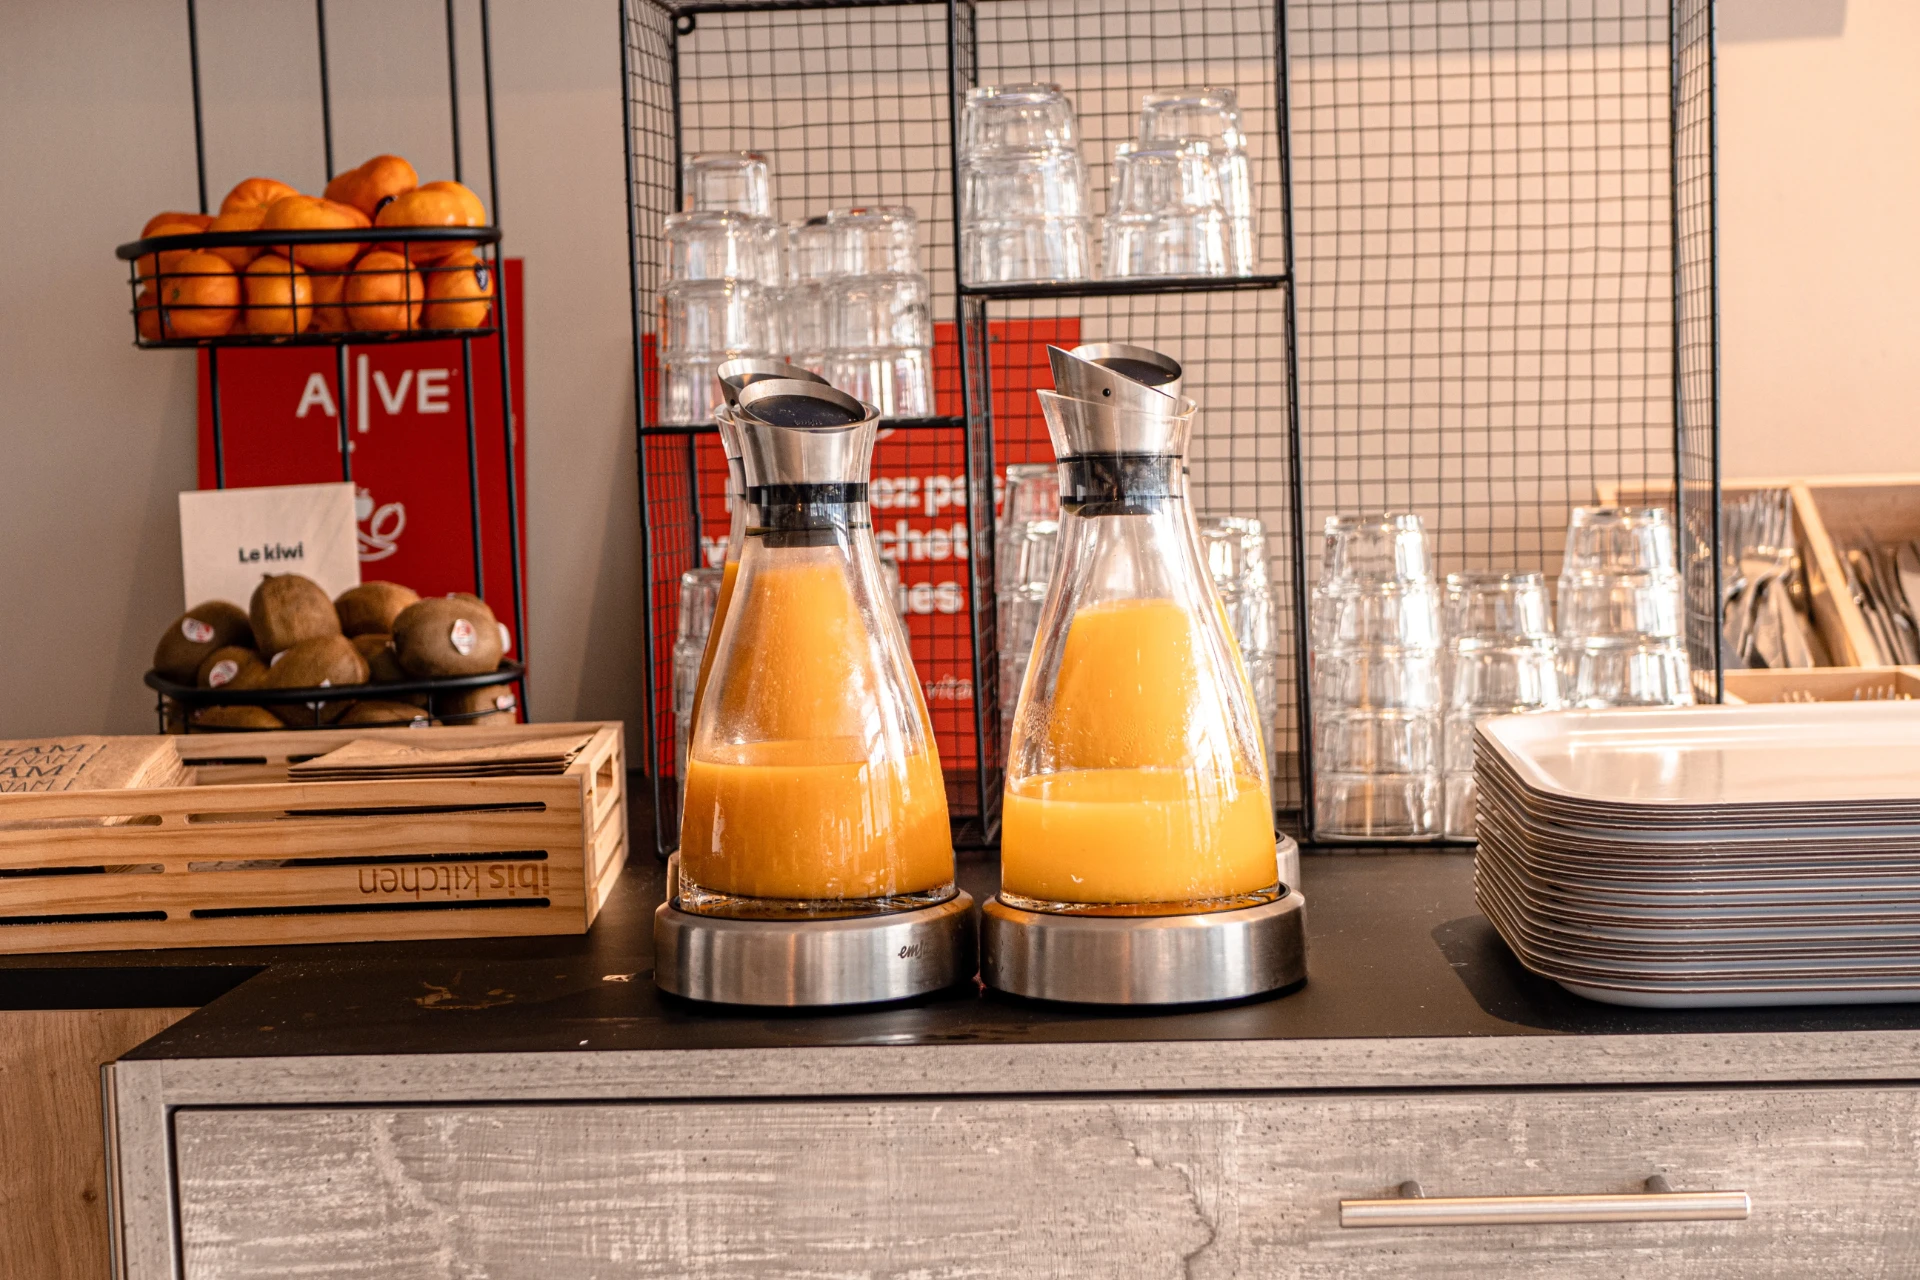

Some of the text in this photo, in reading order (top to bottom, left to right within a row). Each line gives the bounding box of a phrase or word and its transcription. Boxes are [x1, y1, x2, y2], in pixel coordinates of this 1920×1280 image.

[239, 541, 303, 563] Le kiwi
[358, 862, 549, 900] ibis kitchen
